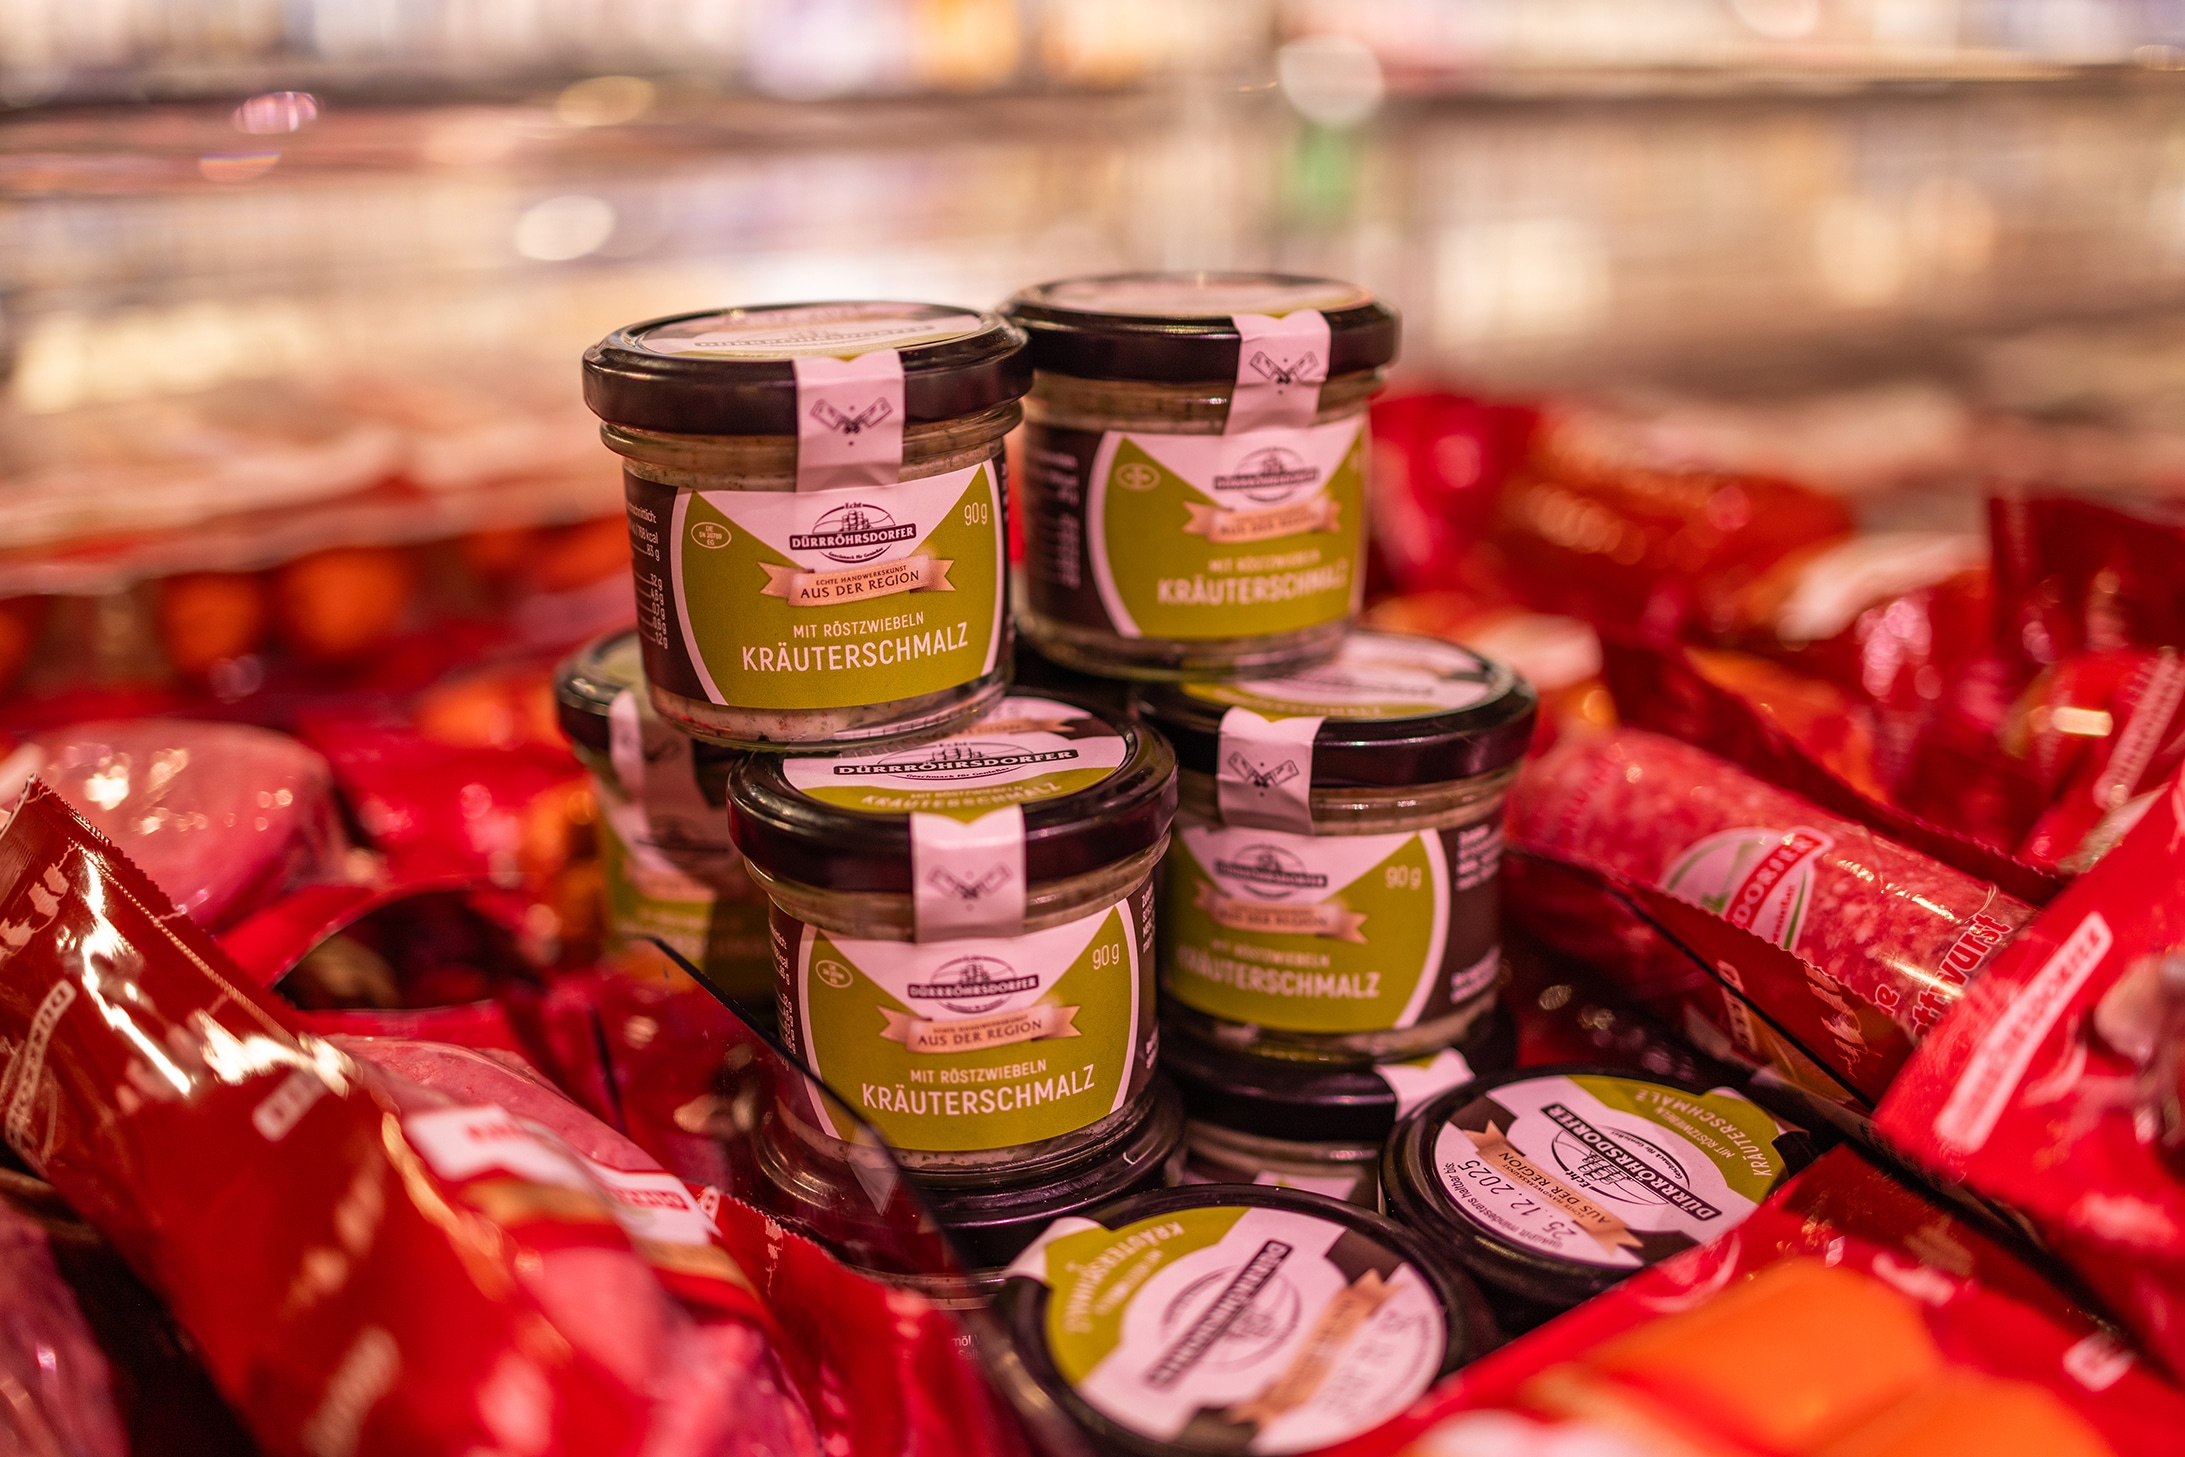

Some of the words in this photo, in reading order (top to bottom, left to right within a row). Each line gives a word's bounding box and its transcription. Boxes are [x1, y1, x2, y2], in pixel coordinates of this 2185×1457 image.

[790, 525, 914, 548] DÜRRRÖHRSDORFER
[800, 585, 830, 599] AUS
[836, 582, 864, 596] DER
[868, 570, 920, 590] REGION
[816, 577, 839, 586] ECHTE
[840, 565, 907, 583] HANDWERKSKUNST
[793, 624, 817, 639] MIT
[823, 611, 925, 637] RÖSTZWIEBELN
[742, 621, 968, 672] KRÄUTERSCHMALZ
[838, 750, 1074, 775] DÜRRRÖHRSDORFER
[917, 1034, 947, 1047] AUS
[953, 1032, 983, 1044] DER
[987, 1018, 1042, 1037] REGION
[910, 1069, 934, 1083] MIT
[940, 1058, 1047, 1084] RÖSTZWIEBELN
[861, 1063, 1095, 1116] KRÄUTERSCHMALZ
[1635, 1088, 1772, 1177] KRÄUTERSCHMALZ
[1547, 1104, 1716, 1219] DÜRRRÖHRSDORFER
[1719, 1148, 1736, 1160] MIT
[1498, 1151, 1551, 1187] REGION
[1565, 1169, 1591, 1189] Echt
[1448, 1171, 1473, 1199] haltbar
[1551, 1185, 1580, 1205] DER
[1467, 1193, 1520, 1232] mindestens
[1580, 1205, 1612, 1224] AUS
